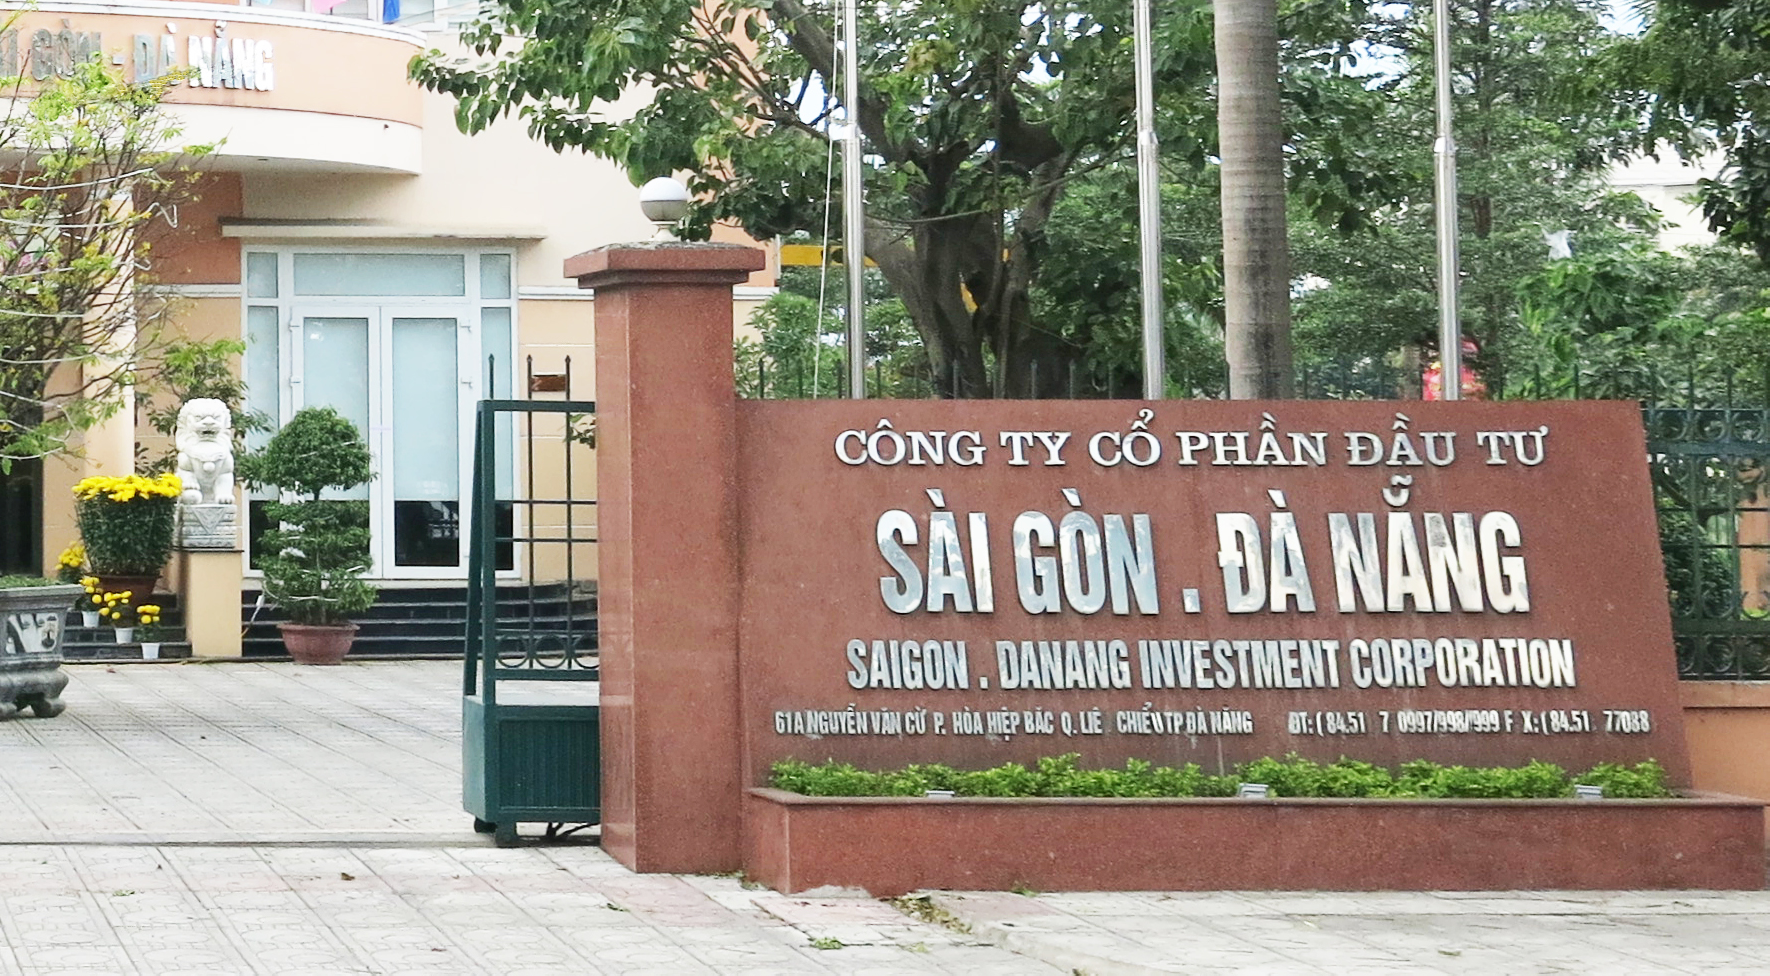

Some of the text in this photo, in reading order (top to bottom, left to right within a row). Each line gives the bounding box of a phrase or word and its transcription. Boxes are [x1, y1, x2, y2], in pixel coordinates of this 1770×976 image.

[834, 408, 1549, 467] CÔNG TY CỔ PHẦN ĐẦU TƯ
[876, 488, 994, 614] SÀI
[1012, 488, 1159, 615] GÒN
[1215, 489, 1316, 613] ĐÀ
[1328, 475, 1530, 613] NẴNG
[846, 639, 969, 690] SAIGON
[996, 639, 1131, 690] DANANG
[1138, 639, 1340, 689] INVESTMENT
[1350, 638, 1576, 689] CORPORATION
[870, 707, 901, 734] VĂN
[905, 706, 927, 734] CỪ
[933, 712, 946, 734] P.
[952, 706, 984, 734] HÒA
[986, 706, 1020, 741] HIỆP
[1185, 706, 1208, 734] ĐÀ
